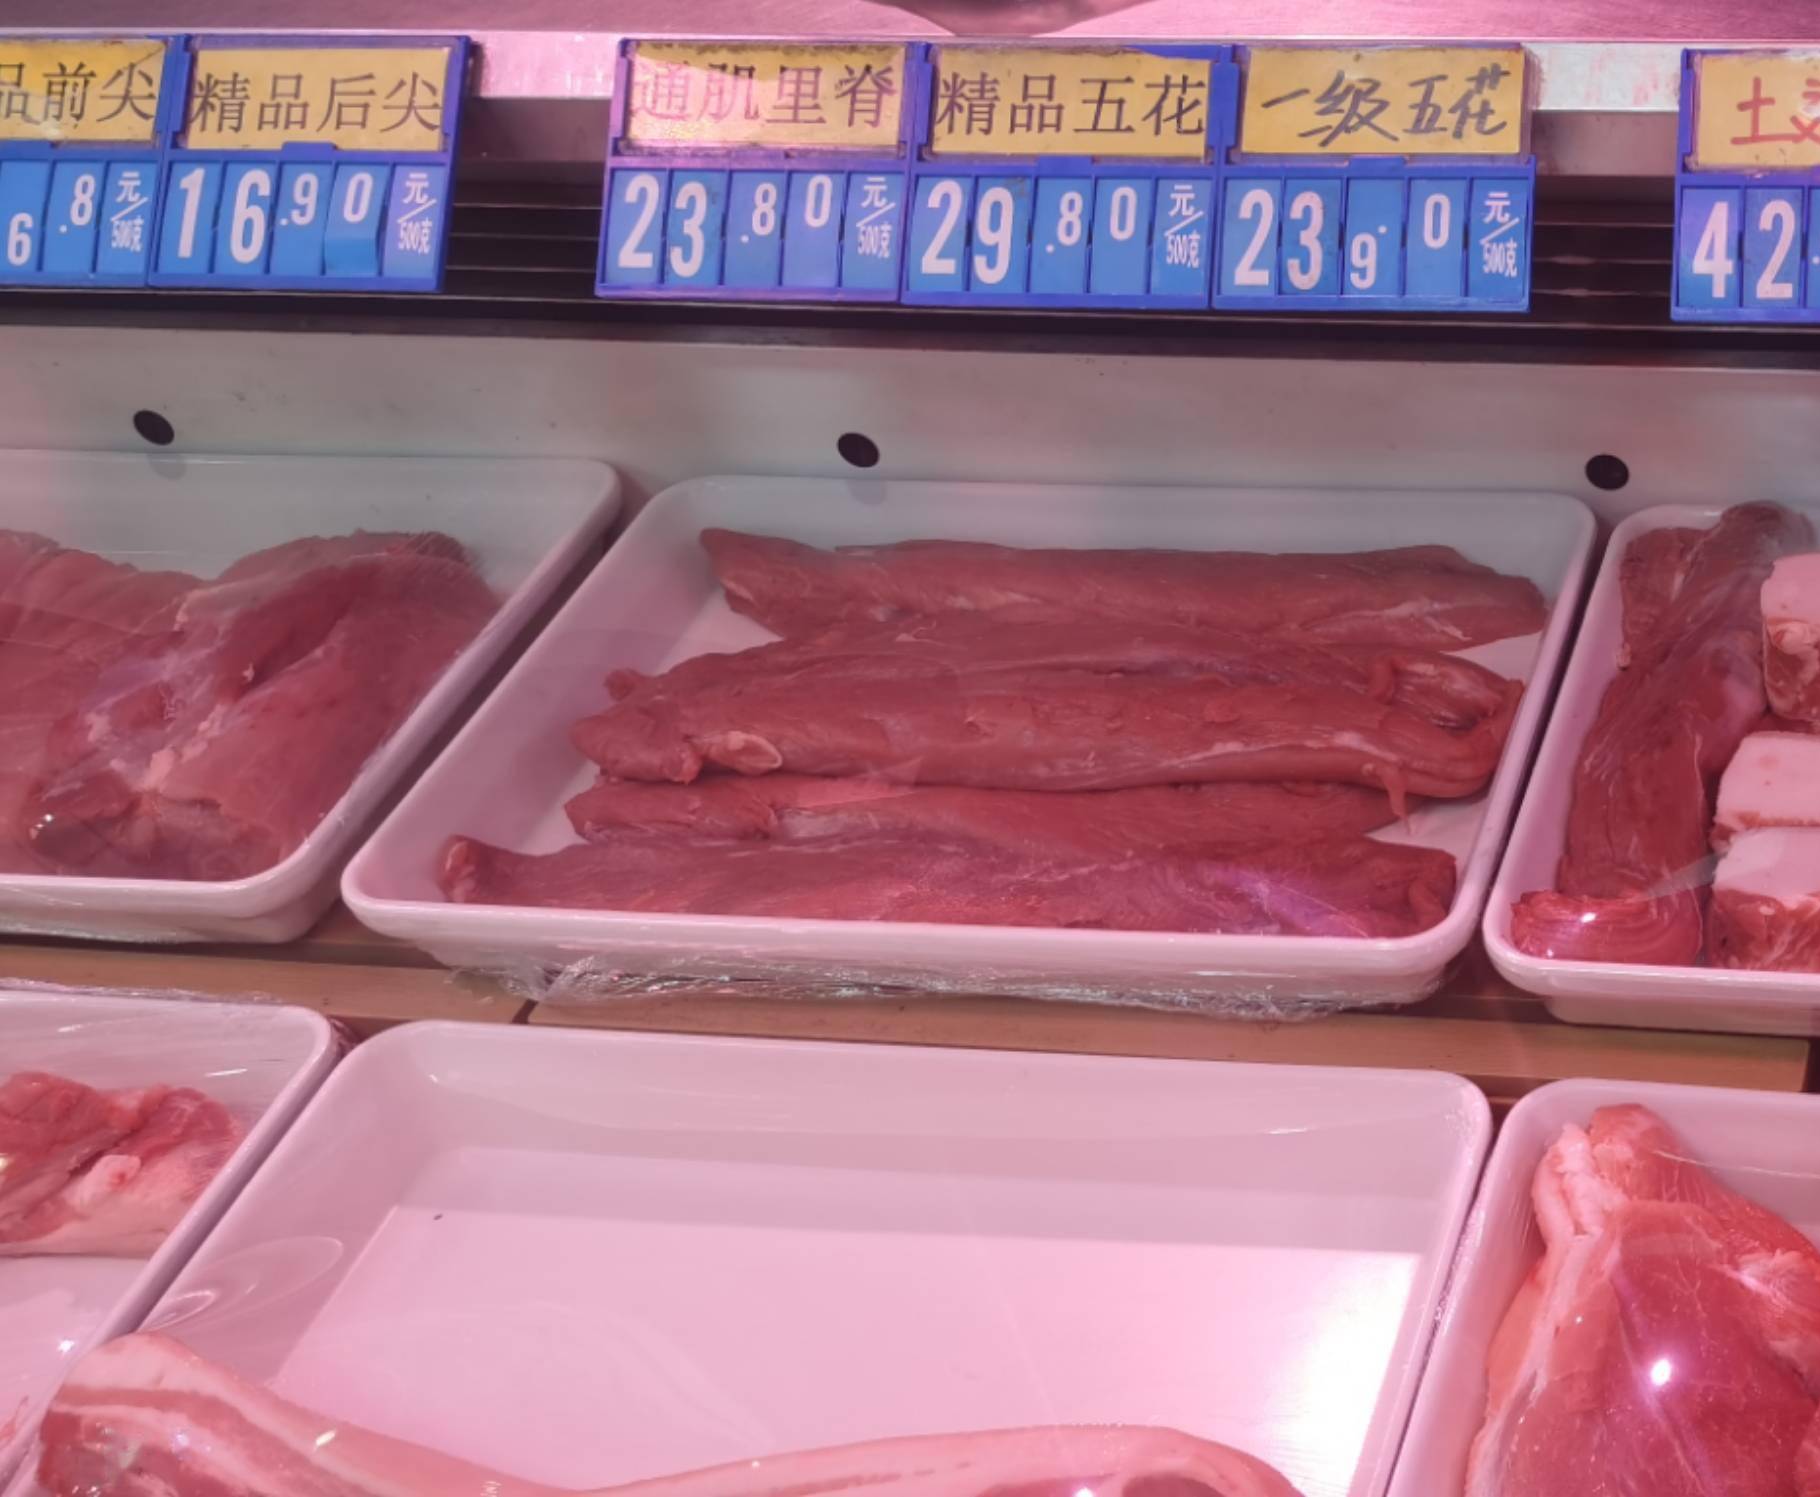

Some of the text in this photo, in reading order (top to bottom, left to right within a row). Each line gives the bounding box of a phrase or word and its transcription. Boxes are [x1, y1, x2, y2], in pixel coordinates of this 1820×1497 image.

[189, 72, 442, 133] 精品后尖
[633, 61, 897, 129] 通肌里脊
[936, 72, 1206, 136] 精品五花
[1261, 63, 1511, 147] 一级五花
[178, 168, 373, 263] 16.90
[618, 173, 832, 278] 23.80
[921, 180, 1138, 284] 29.80
